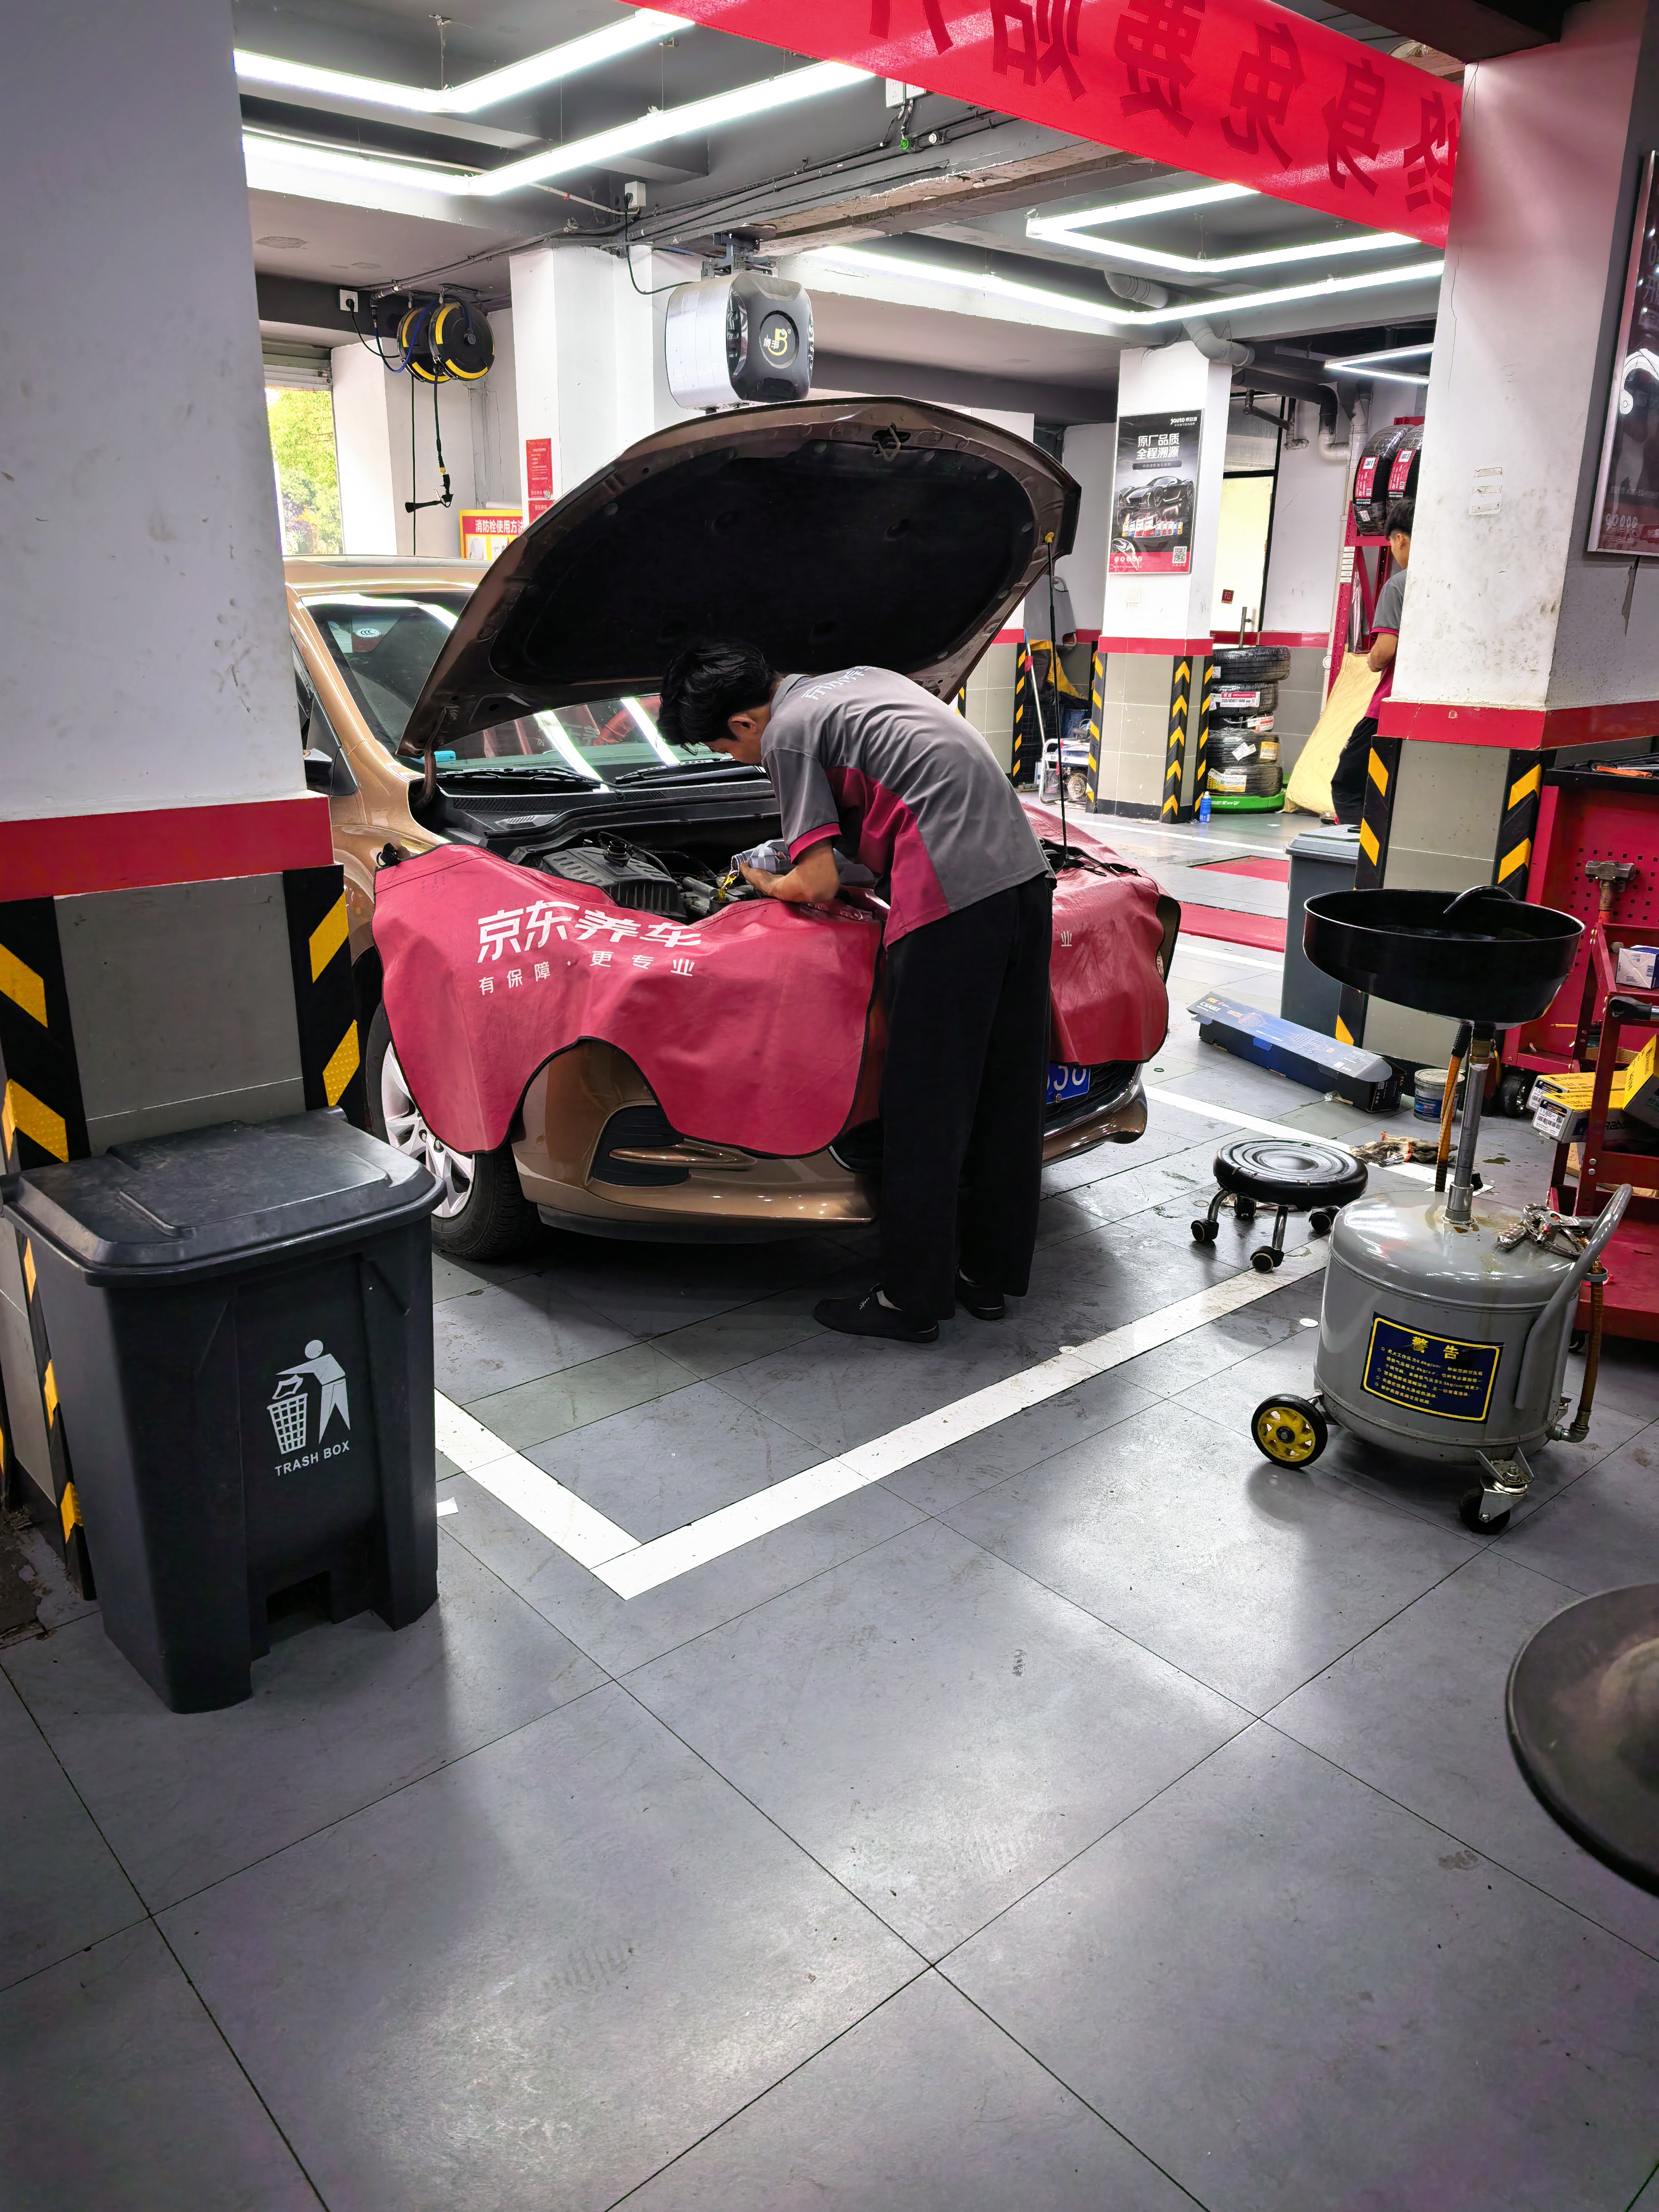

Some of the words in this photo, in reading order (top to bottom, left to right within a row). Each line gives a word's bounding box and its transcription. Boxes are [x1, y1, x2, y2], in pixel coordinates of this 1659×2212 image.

[1137, 433, 1180, 447] 原厂品质
[1136, 446, 1180, 460] 全程溯源
[1224, 591, 1232, 599] 拉
[477, 900, 702, 964] 京东养车
[1411, 1336, 1460, 1360] 警告
[274, 1452, 318, 1477] TRASH
[323, 1440, 350, 1459] BOX
